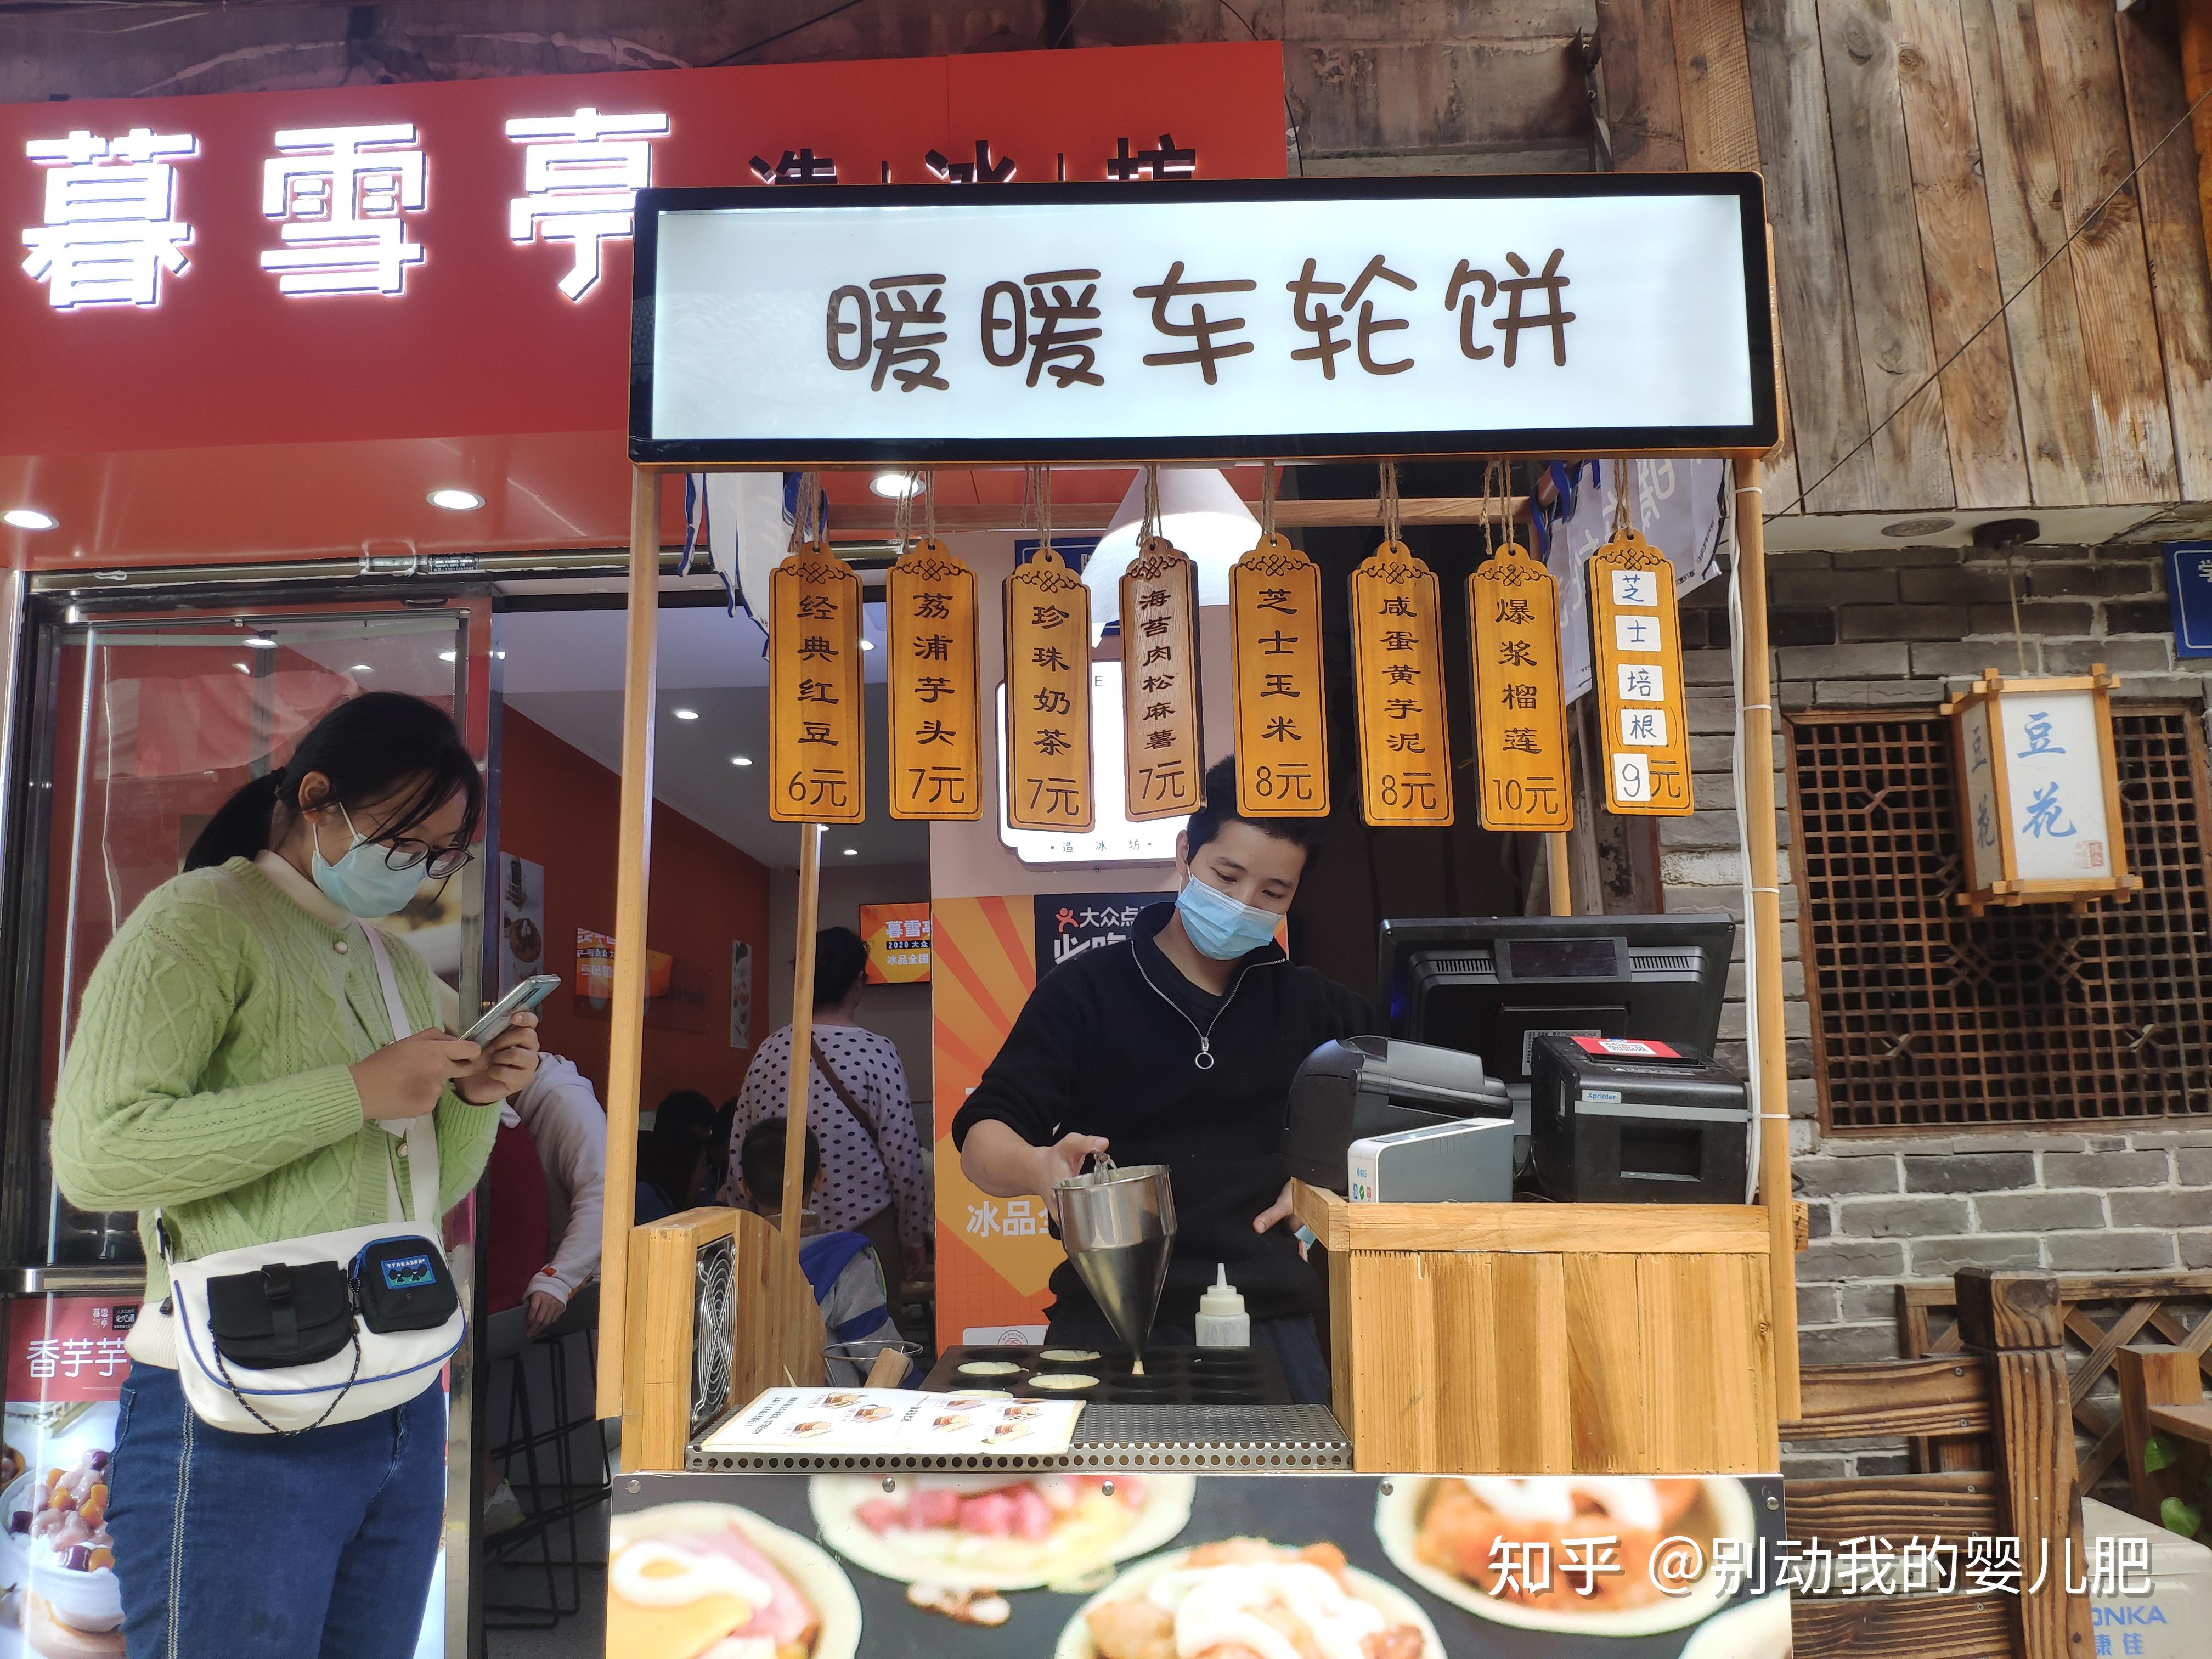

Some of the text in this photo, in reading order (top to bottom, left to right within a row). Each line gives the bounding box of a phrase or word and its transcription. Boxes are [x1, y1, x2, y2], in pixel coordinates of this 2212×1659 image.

[21, 108, 672, 311] 暮雪亭
[826, 246, 1576, 393] 暖暖车轮饼
[797, 594, 839, 746] 经典红豆
[912, 591, 956, 746] 荔浦芋头
[1140, 589, 1177, 752] 海苔肉松麻薯
[1256, 588, 1303, 743] 芝士玉米
[1378, 595, 1426, 755] 咸蛋黄芋泥
[1494, 597, 1543, 755] 爆浆榴莲
[1622, 574, 1658, 740] 芝士培根
[1032, 604, 1071, 757] 珍珠奶茶
[788, 768, 847, 808] 6元
[907, 766, 966, 804] 7元
[1026, 777, 1079, 816] 7元
[1138, 759, 1186, 802] 7元
[1256, 763, 1313, 802] 8元
[1381, 771, 1436, 810] 8元
[1493, 776, 1559, 815] 10元
[1622, 760, 1681, 798] 9元
[1972, 725, 1995, 849] 豆花
[2017, 712, 2077, 840] 豆花
[1079, 906, 1146, 928] 大众点
[887, 953, 929, 965] 冰品全国
[1588, 1092, 1616, 1101] Xprinter
[26, 1336, 128, 1378] 香芋芋
[2095, 1632, 2144, 1656] 康佳
